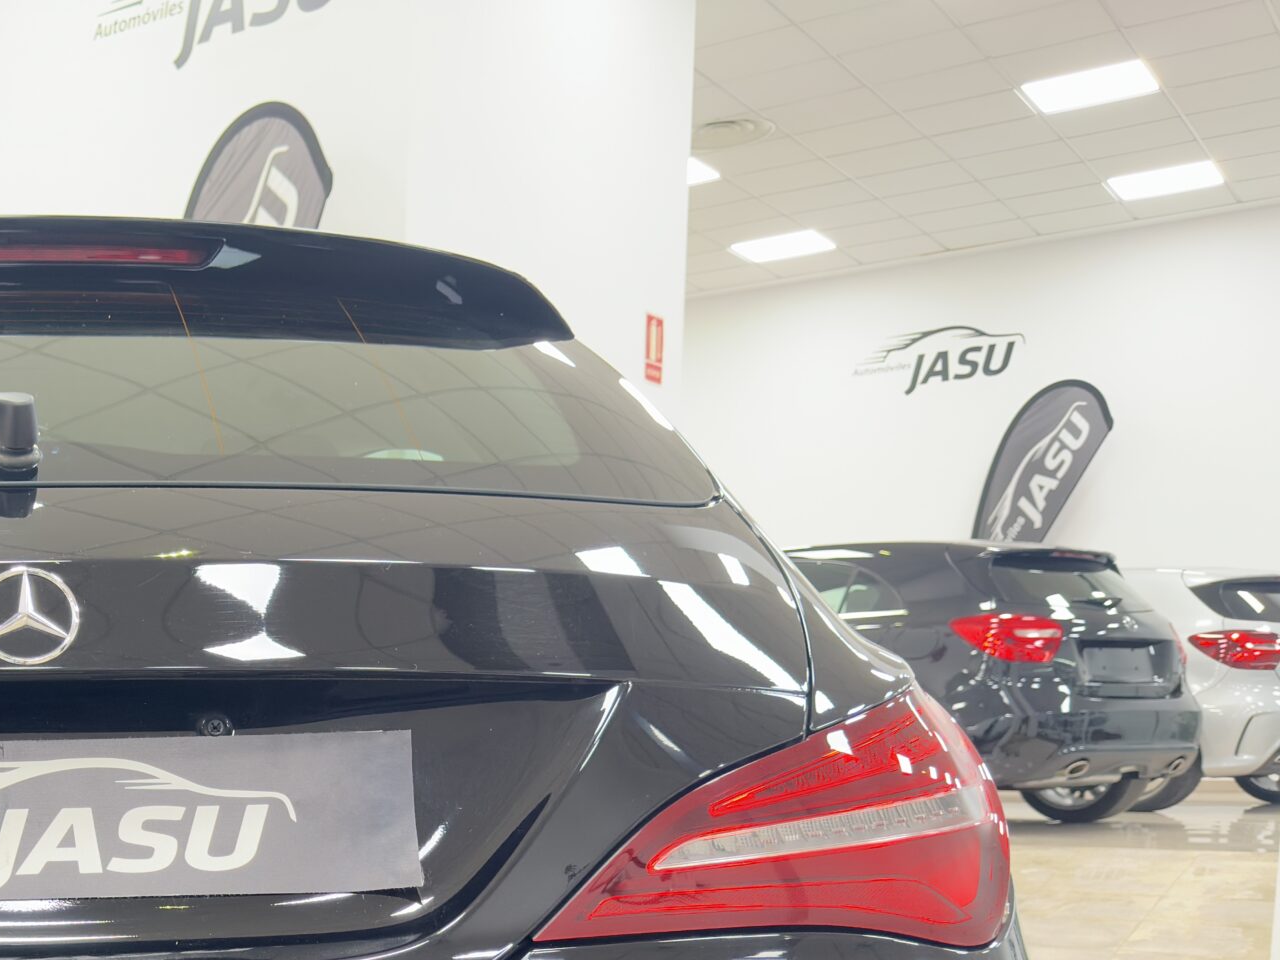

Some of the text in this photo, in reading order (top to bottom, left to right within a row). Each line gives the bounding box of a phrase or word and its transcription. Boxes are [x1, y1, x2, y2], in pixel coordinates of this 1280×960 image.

[93, 0, 184, 41] Automóviles
[904, 340, 1016, 396] JASU
[1017, 410, 1091, 529] JASU
